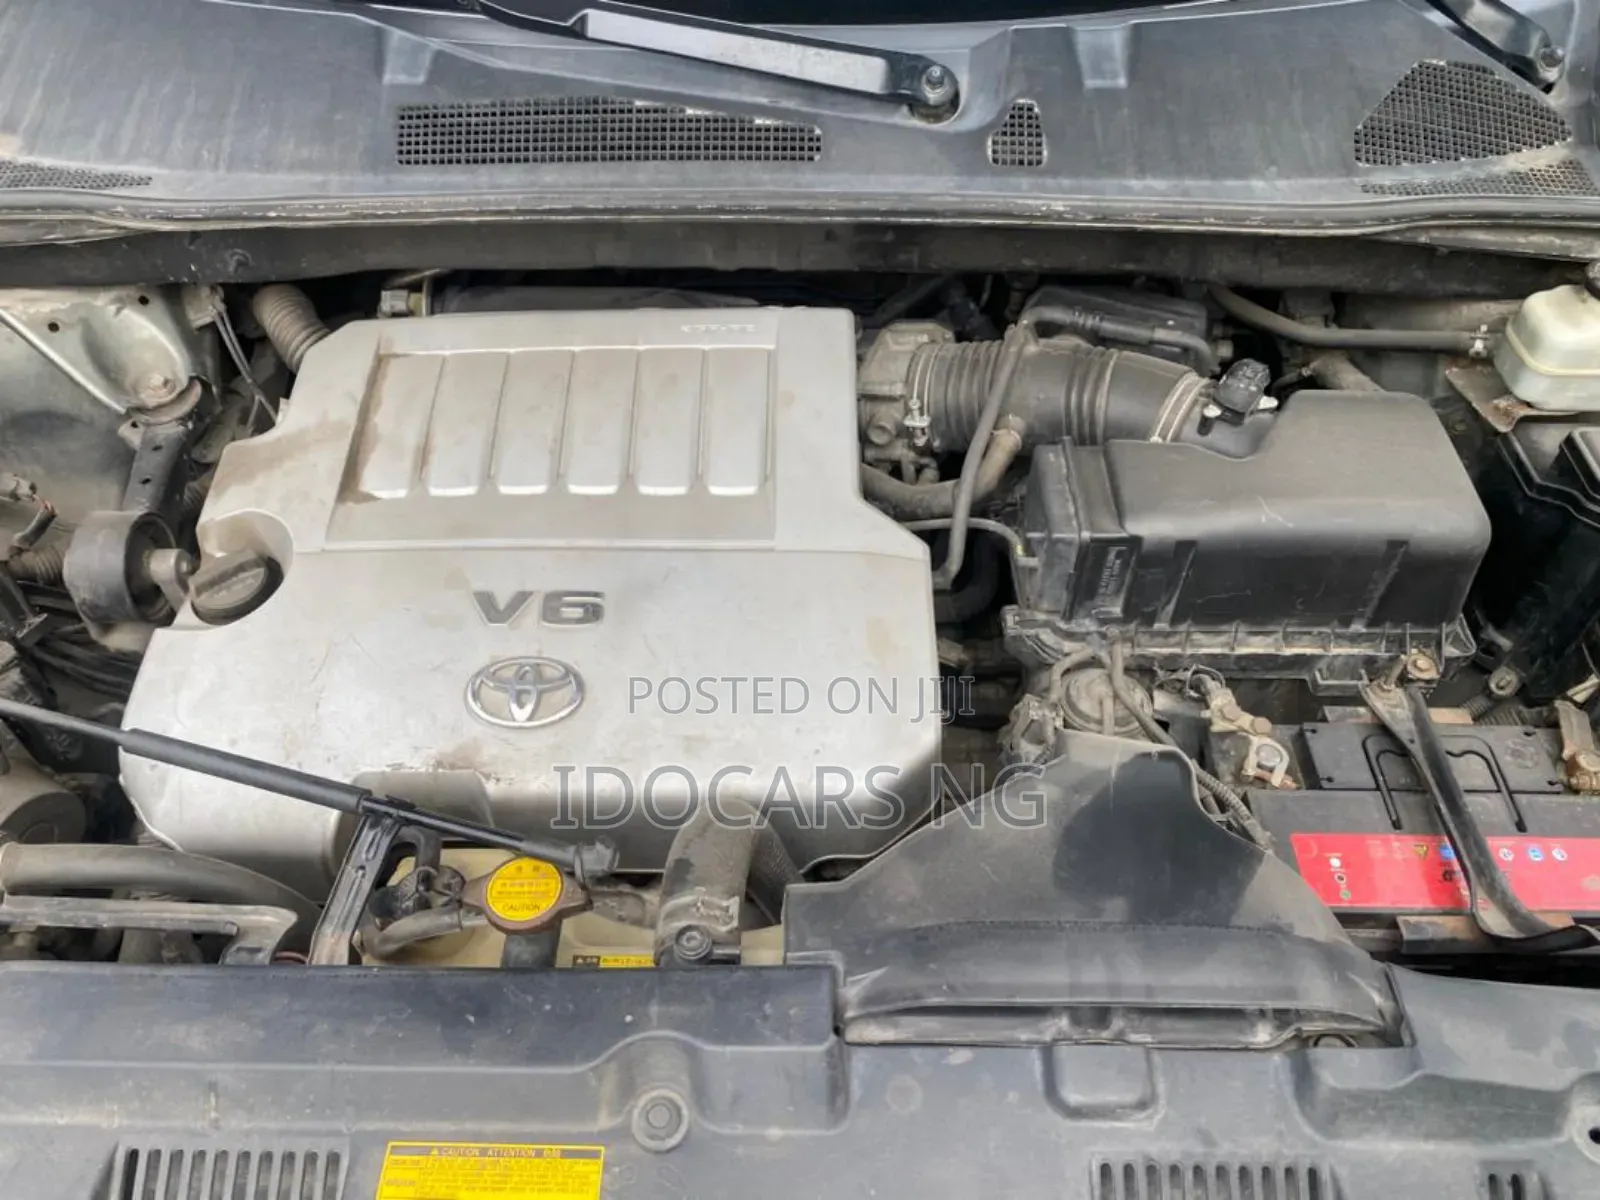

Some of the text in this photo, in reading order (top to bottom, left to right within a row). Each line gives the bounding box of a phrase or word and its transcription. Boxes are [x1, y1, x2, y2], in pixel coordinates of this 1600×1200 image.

[472, 590, 605, 627] V6
[502, 902, 541, 912] CAUTION
[441, 1147, 479, 1157] CAUTION
[487, 1147, 536, 1158] ATTENTION
